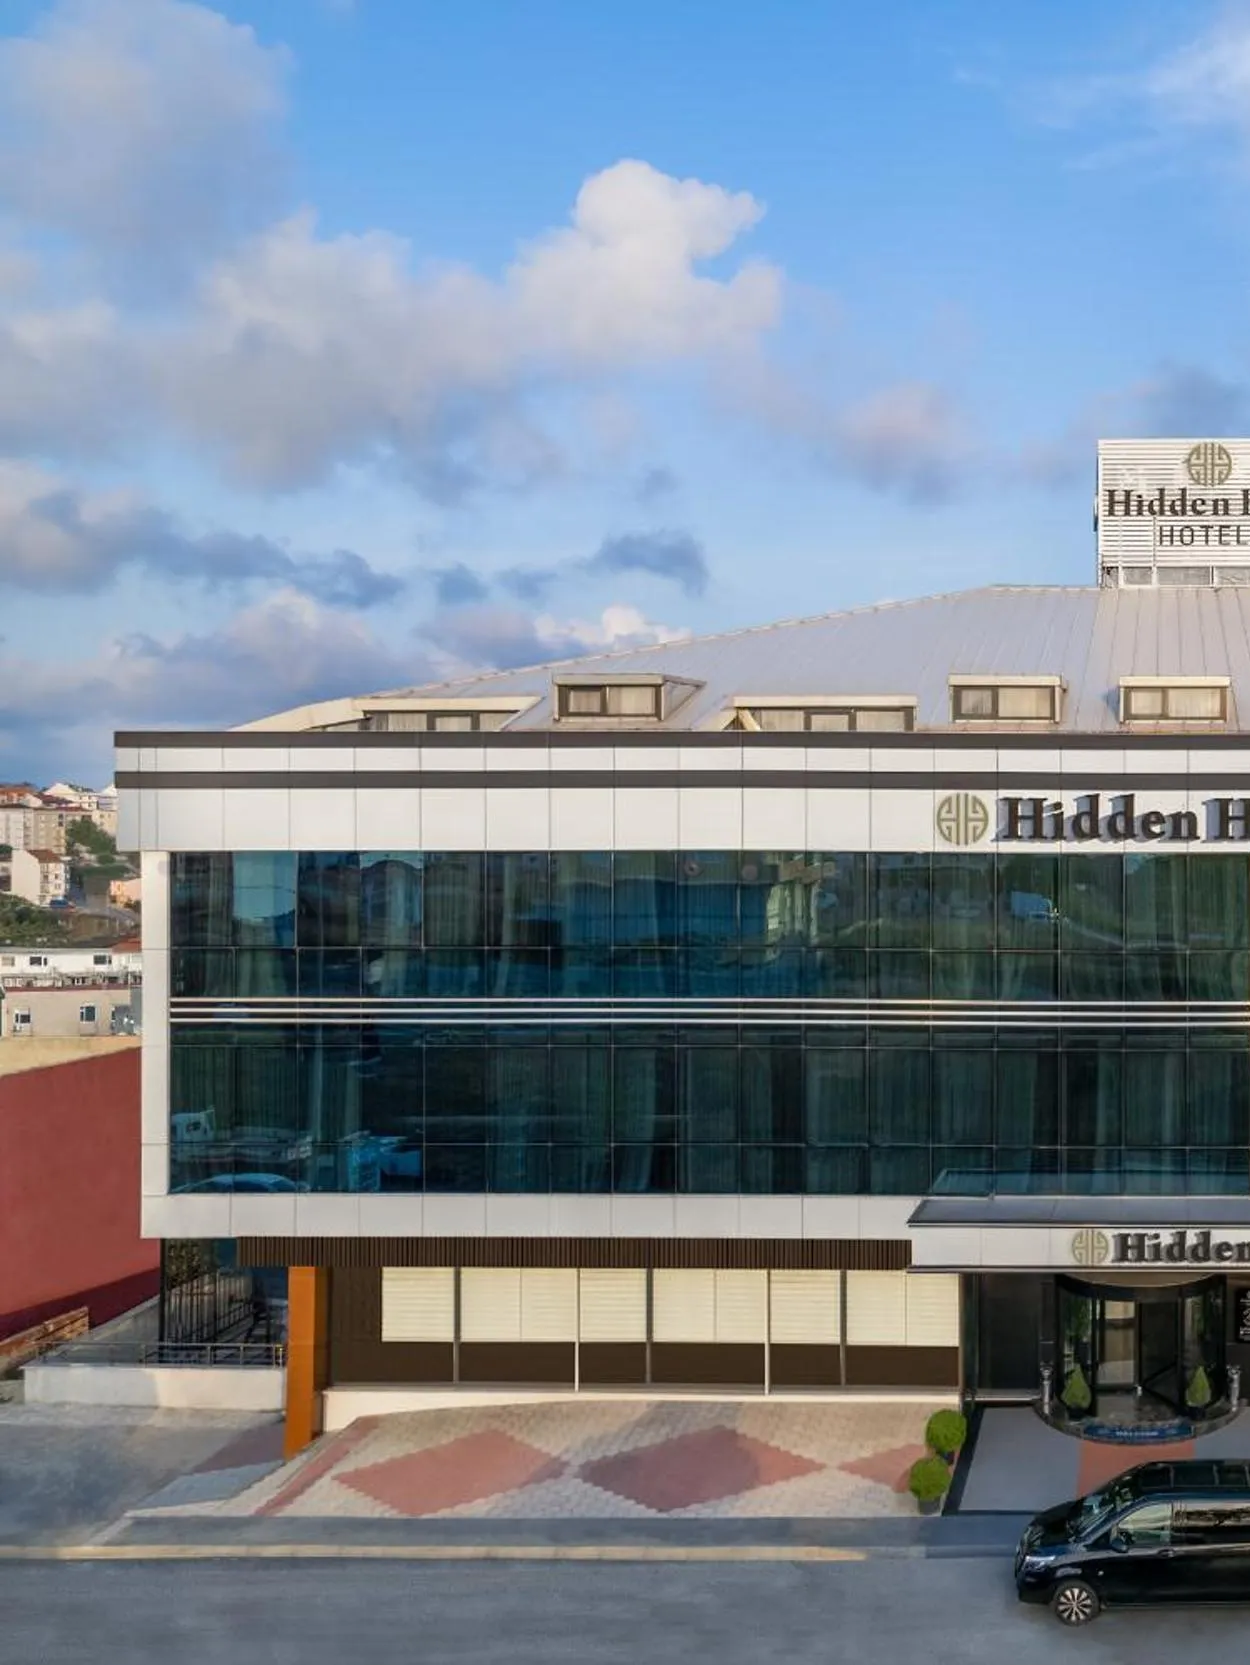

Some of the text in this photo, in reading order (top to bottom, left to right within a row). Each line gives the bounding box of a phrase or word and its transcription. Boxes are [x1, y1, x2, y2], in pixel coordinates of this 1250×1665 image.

[1104, 487, 1230, 517] Hidden
[1159, 525, 1249, 547] HOTEL
[994, 793, 1200, 842] Hidden
